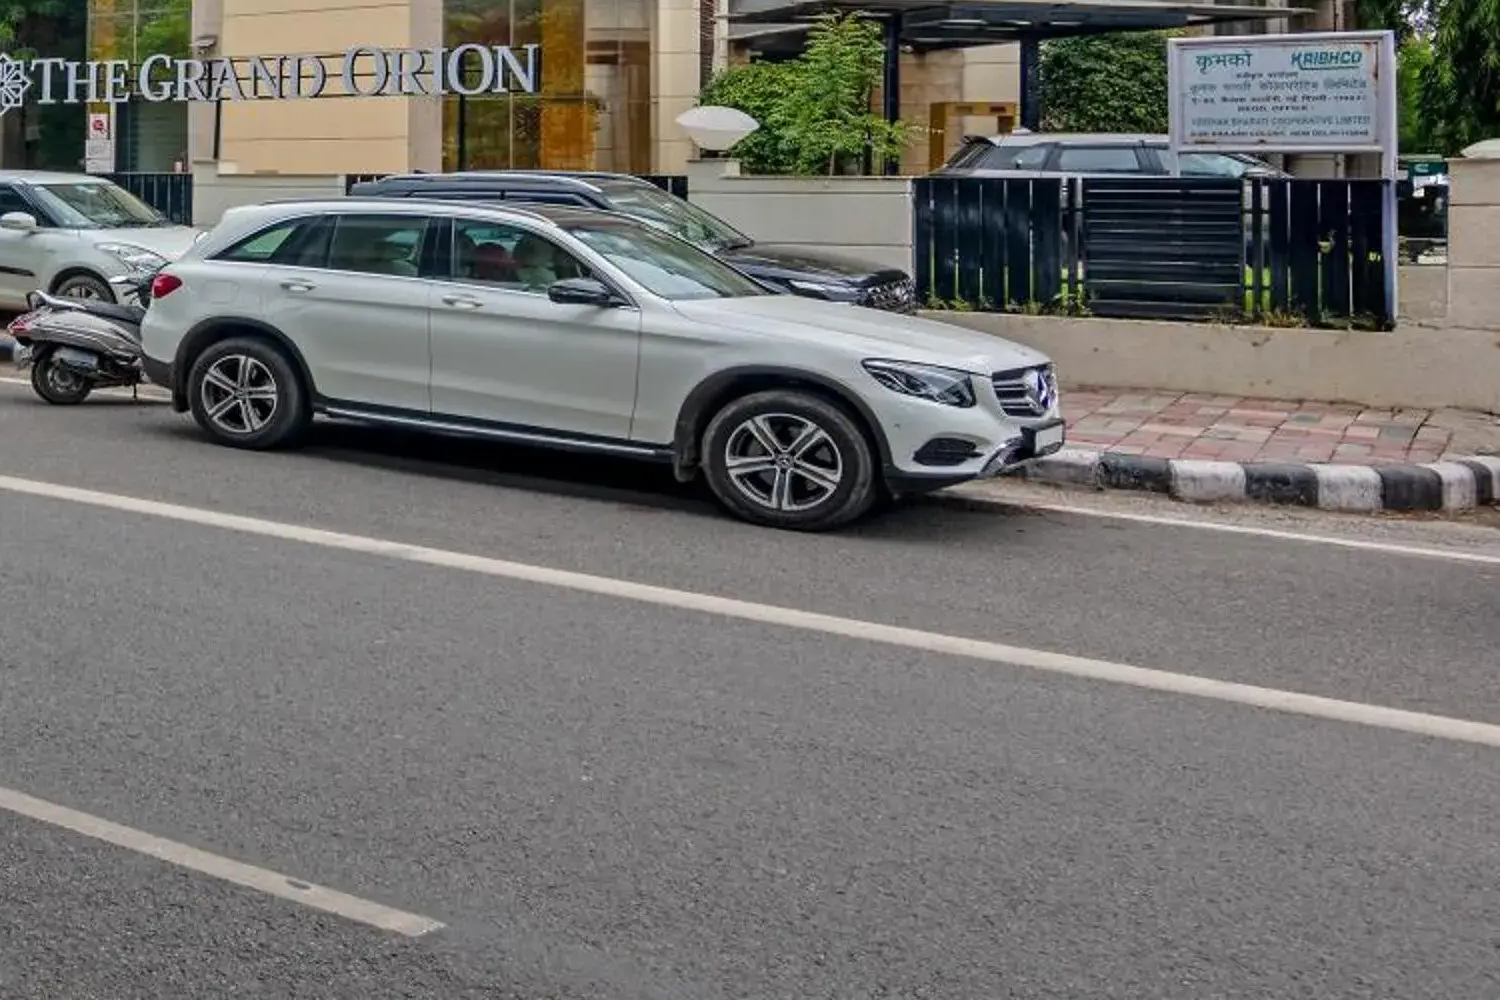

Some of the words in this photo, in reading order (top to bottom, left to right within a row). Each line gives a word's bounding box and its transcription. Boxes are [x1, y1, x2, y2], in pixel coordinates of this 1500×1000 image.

[30, 56, 130, 104] THE
[139, 53, 326, 101] GRAND
[342, 43, 537, 98] ORION
[1291, 51, 1362, 69] KRIBHCO
